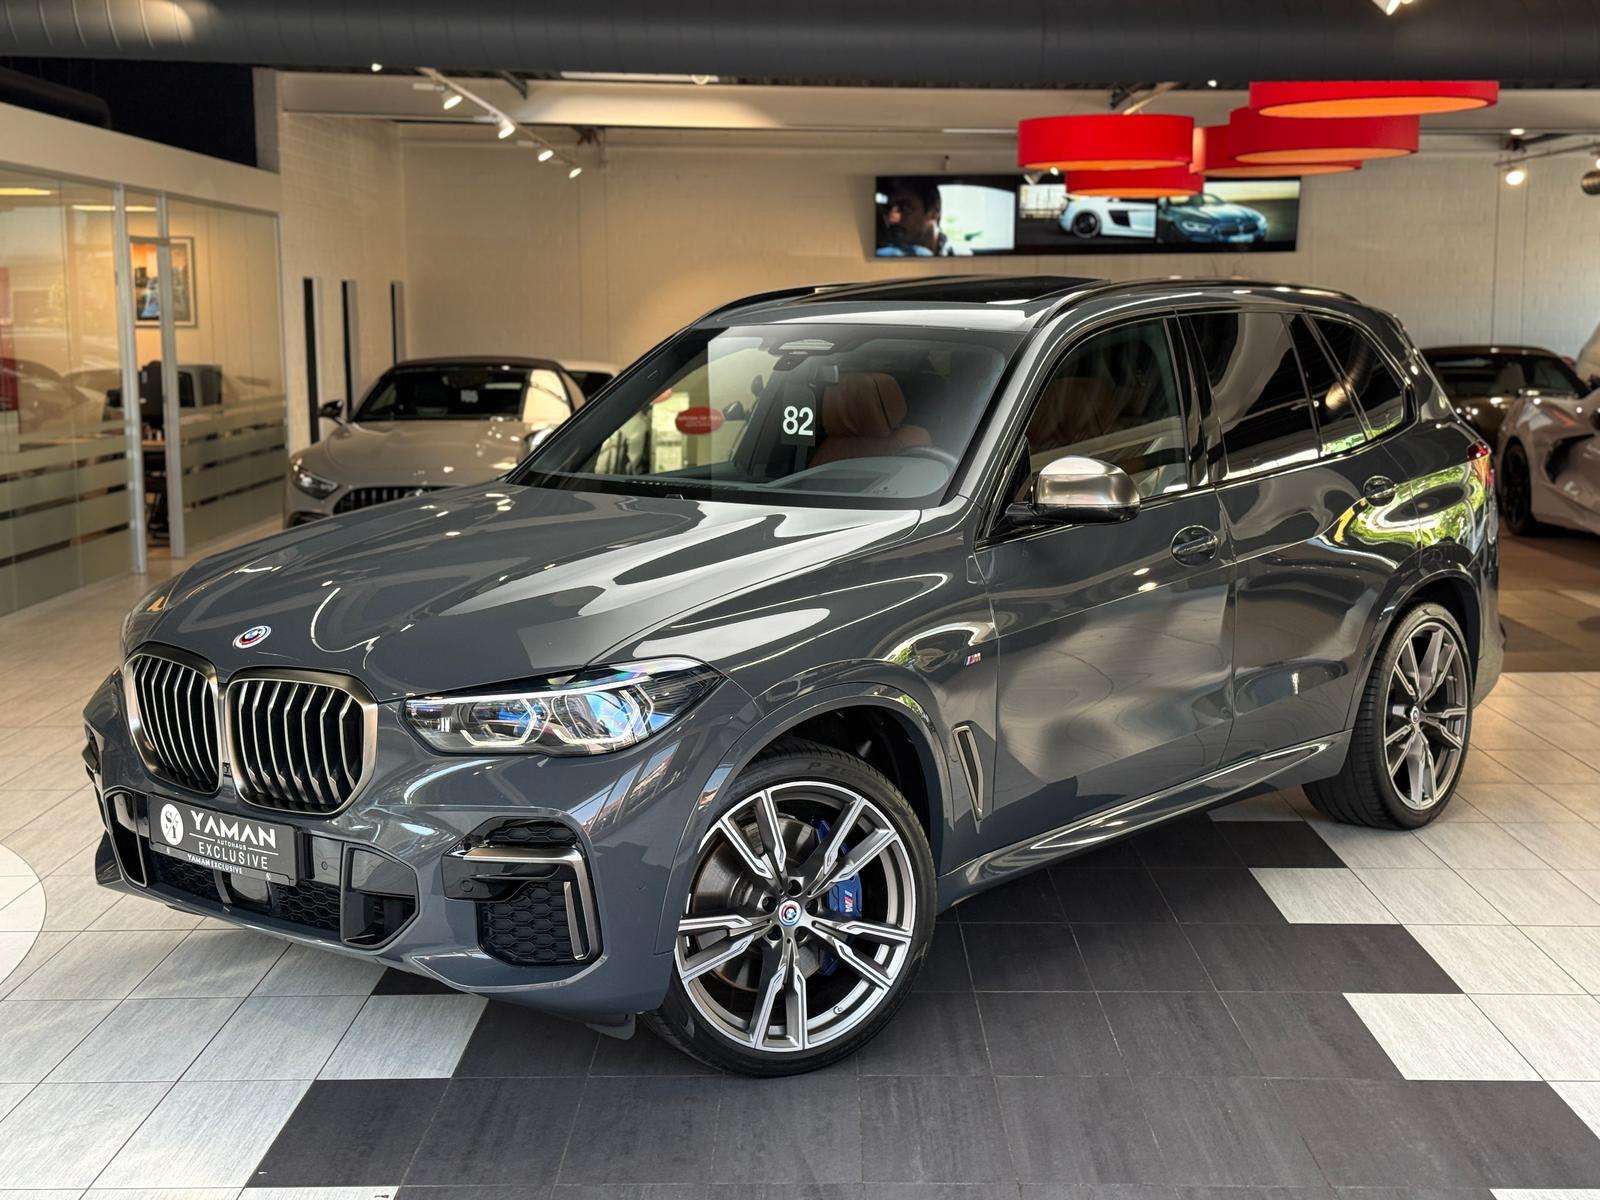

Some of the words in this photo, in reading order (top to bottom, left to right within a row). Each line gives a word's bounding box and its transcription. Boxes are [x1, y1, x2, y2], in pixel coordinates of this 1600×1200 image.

[782, 405, 814, 436] 82
[190, 810, 276, 849] YAMAN
[198, 841, 269, 870] EXCLUSIVE
